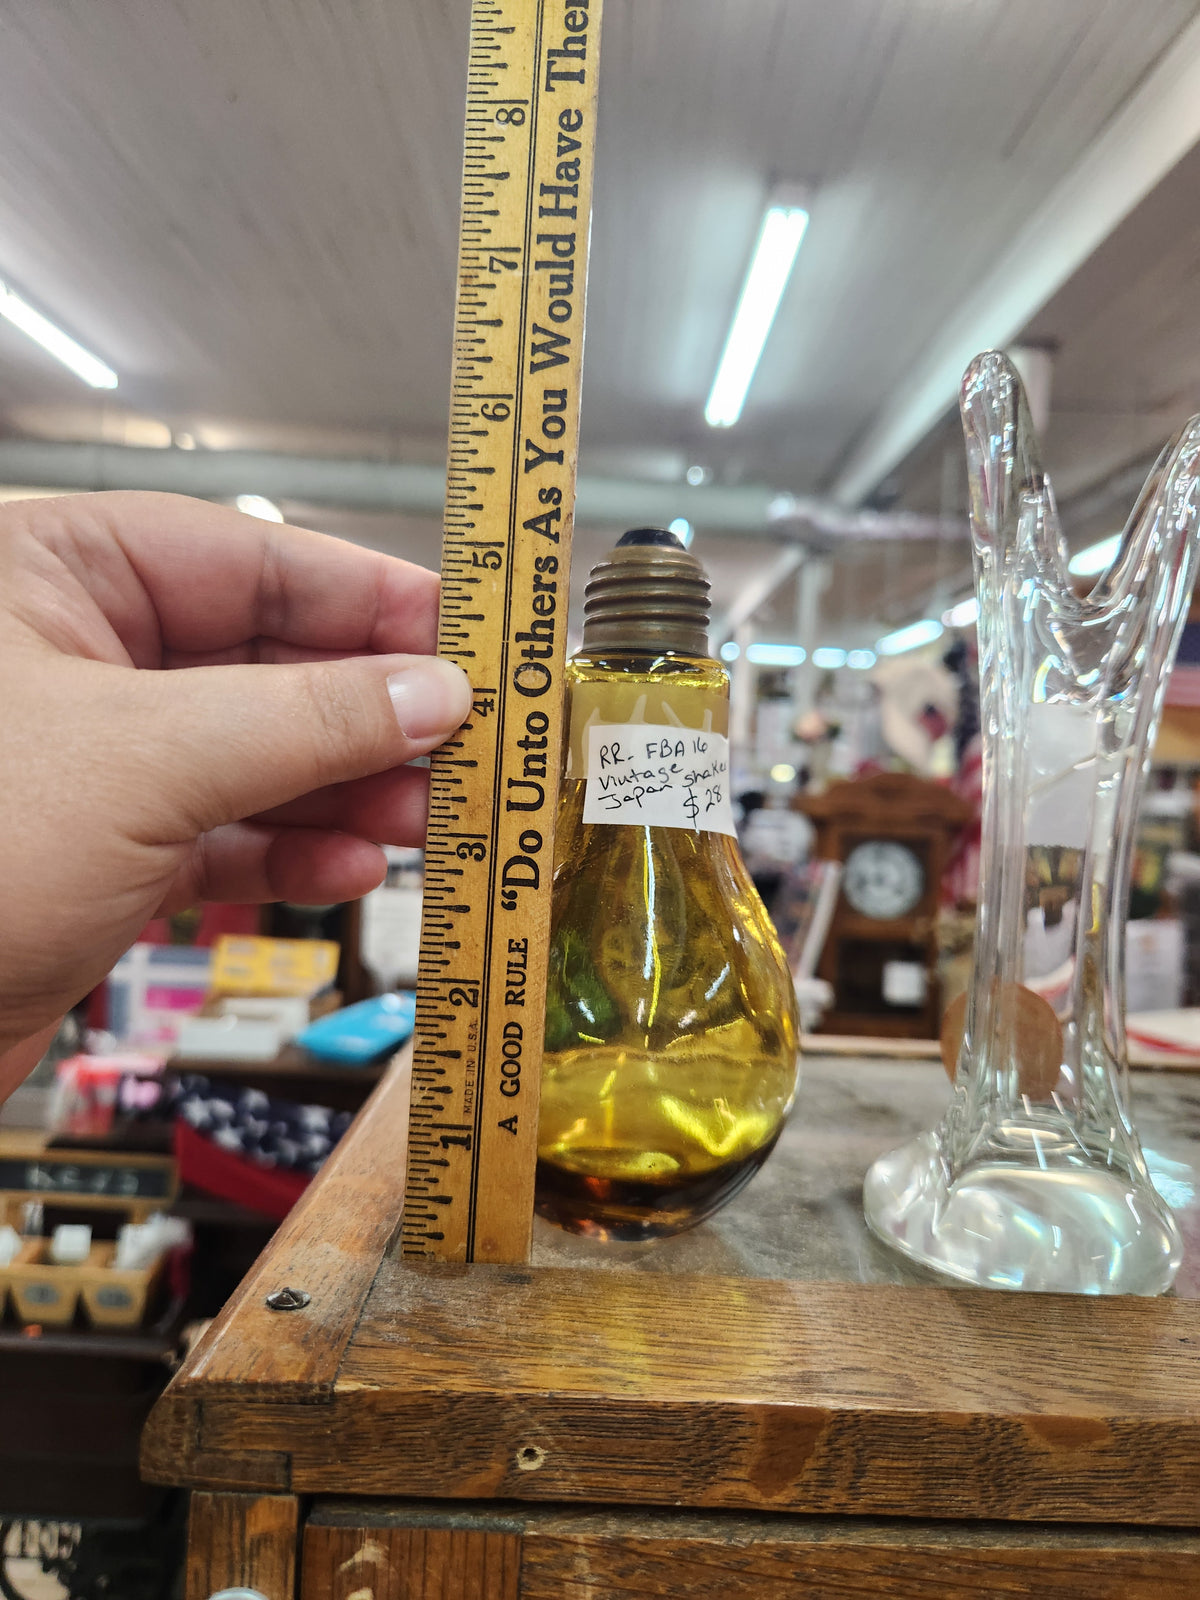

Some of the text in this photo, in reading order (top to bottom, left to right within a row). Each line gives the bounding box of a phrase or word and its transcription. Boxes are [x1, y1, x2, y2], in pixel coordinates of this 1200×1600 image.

[494, 106, 527, 127] 8
[538, 107, 584, 221] Have
[488, 255, 519, 275] 7
[529, 232, 577, 375] Would
[480, 401, 512, 423] 6
[524, 388, 568, 474] You
[522, 486, 563, 544] As
[471, 550, 503, 571] 5
[513, 555, 560, 698] Others
[471, 696, 495, 717] 4
[506, 710, 550, 812] Unto
[456, 841, 487, 862] 3
[448, 986, 479, 1009] 2
[498, 937, 529, 1136] A GOOD RULE
[466, 1059, 476, 1076] IN
[463, 1079, 475, 1115] MADE
[439, 1133, 472, 1151] 1
